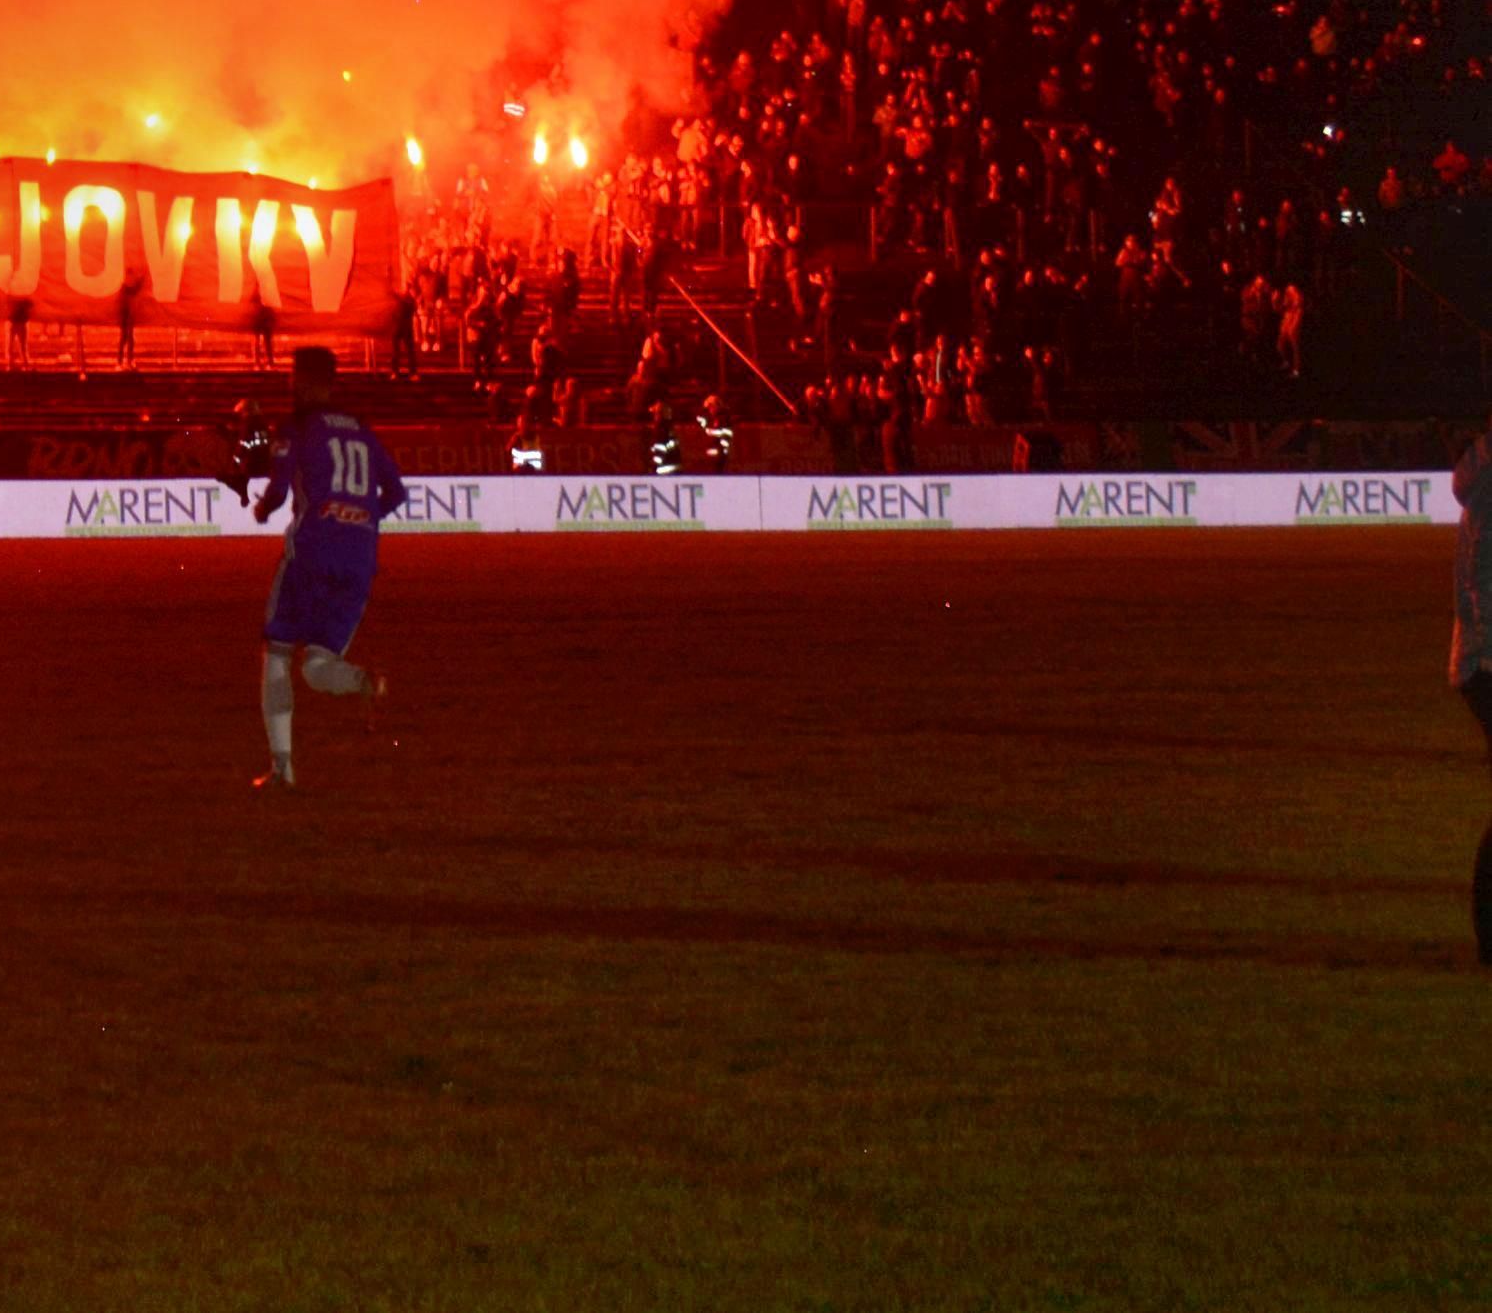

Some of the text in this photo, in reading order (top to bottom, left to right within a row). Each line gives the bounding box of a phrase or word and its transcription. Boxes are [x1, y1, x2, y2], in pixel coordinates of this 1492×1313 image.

[327, 437, 369, 496] 10
[66, 487, 221, 525] MARENT
[557, 483, 704, 520] MARENT
[808, 483, 952, 519] MARENT
[1056, 482, 1197, 516] MARENT
[1296, 480, 1430, 514] MARENT
